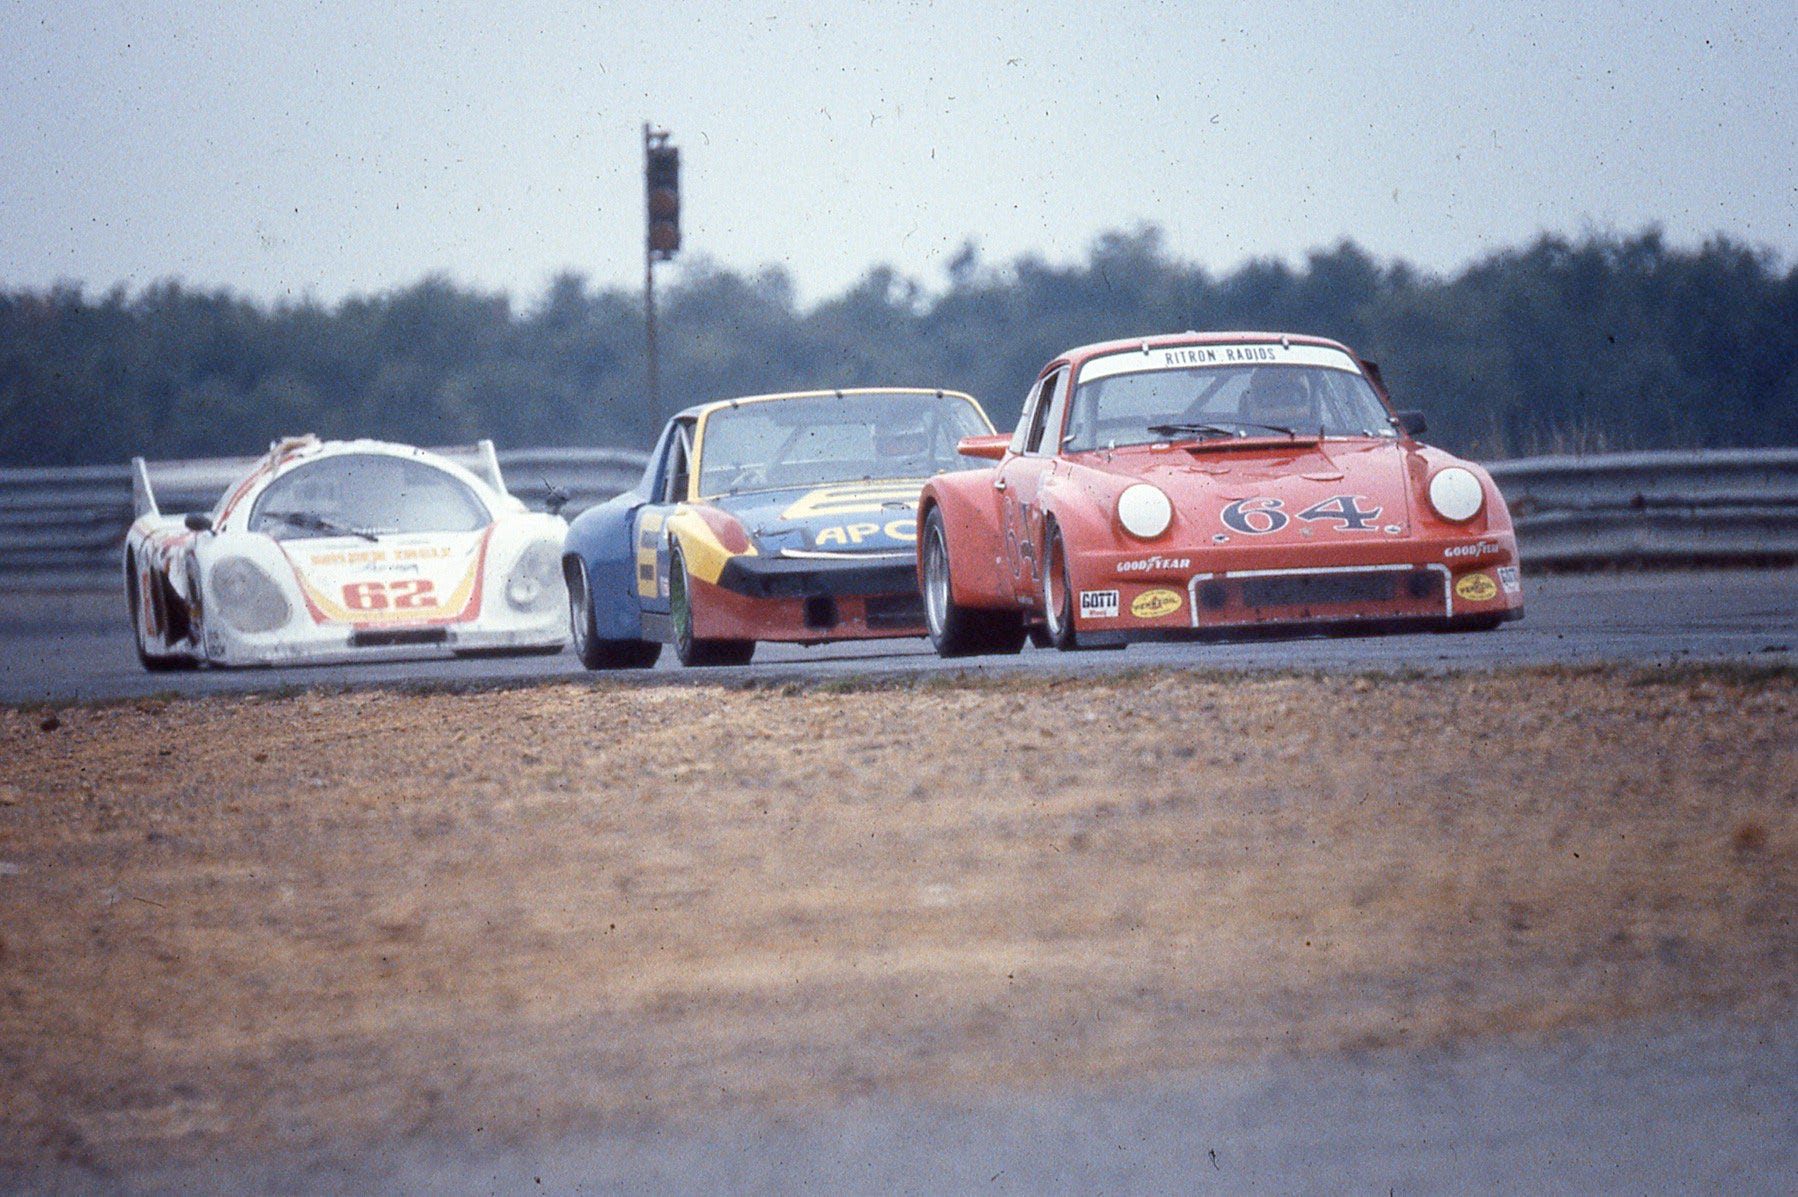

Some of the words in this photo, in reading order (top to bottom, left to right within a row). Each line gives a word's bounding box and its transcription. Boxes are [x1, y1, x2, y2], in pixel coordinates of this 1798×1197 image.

[1164, 349, 1217, 365] RITRON
[1225, 348, 1276, 361] RADIOS
[1220, 495, 1383, 536] 64
[1116, 555, 1191, 573] GOODYEAR
[342, 579, 439, 610] 62
[1082, 592, 1117, 609] GOTTI
